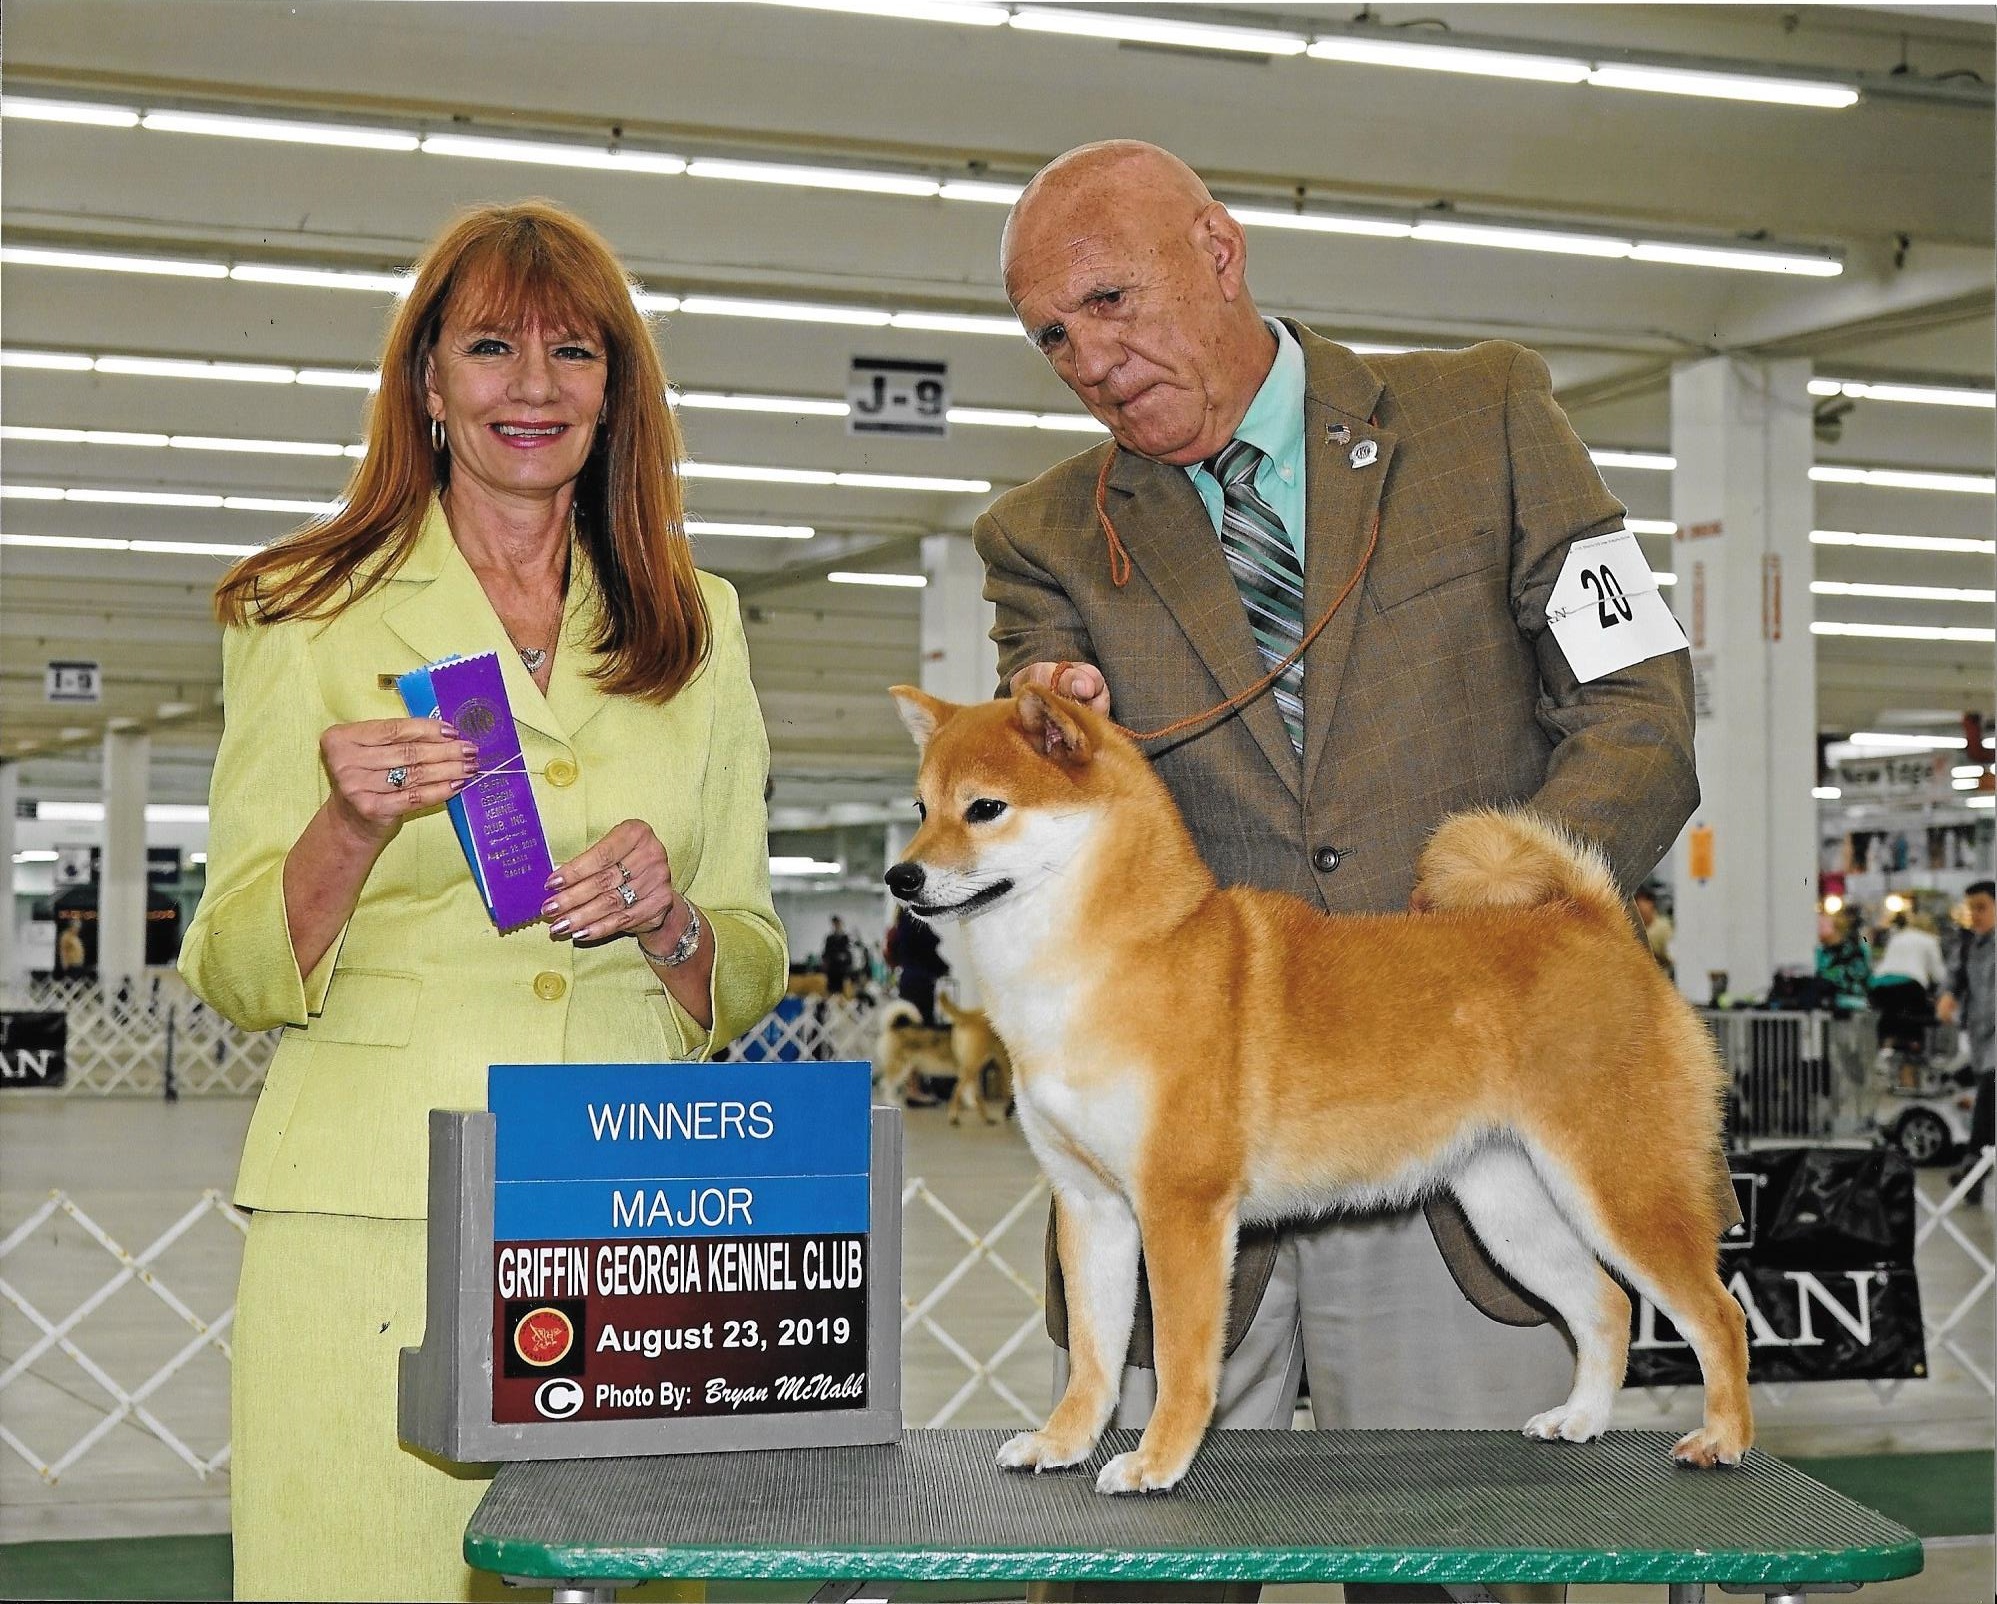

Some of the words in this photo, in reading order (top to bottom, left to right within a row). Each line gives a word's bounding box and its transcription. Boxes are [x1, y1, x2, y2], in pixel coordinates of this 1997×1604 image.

[856, 375, 944, 416] J-9
[1580, 564, 1633, 629] 20
[485, 803, 518, 820] KENNEL
[587, 1101, 775, 1141] WINNERS
[612, 1188, 754, 1228] MAJOR
[498, 1246, 589, 1299] GRIFFIN
[596, 1244, 702, 1296] GEORGIA
[707, 1242, 797, 1292] KENNEL
[803, 1240, 863, 1290] CLUB
[596, 1323, 713, 1358] August
[722, 1321, 768, 1352] 23,
[778, 1317, 851, 1347] 2019
[596, 1383, 653, 1408] Photo
[660, 1381, 691, 1412] By:
[705, 1377, 770, 1409] Bryan
[774, 1372, 866, 1402] McNabb
